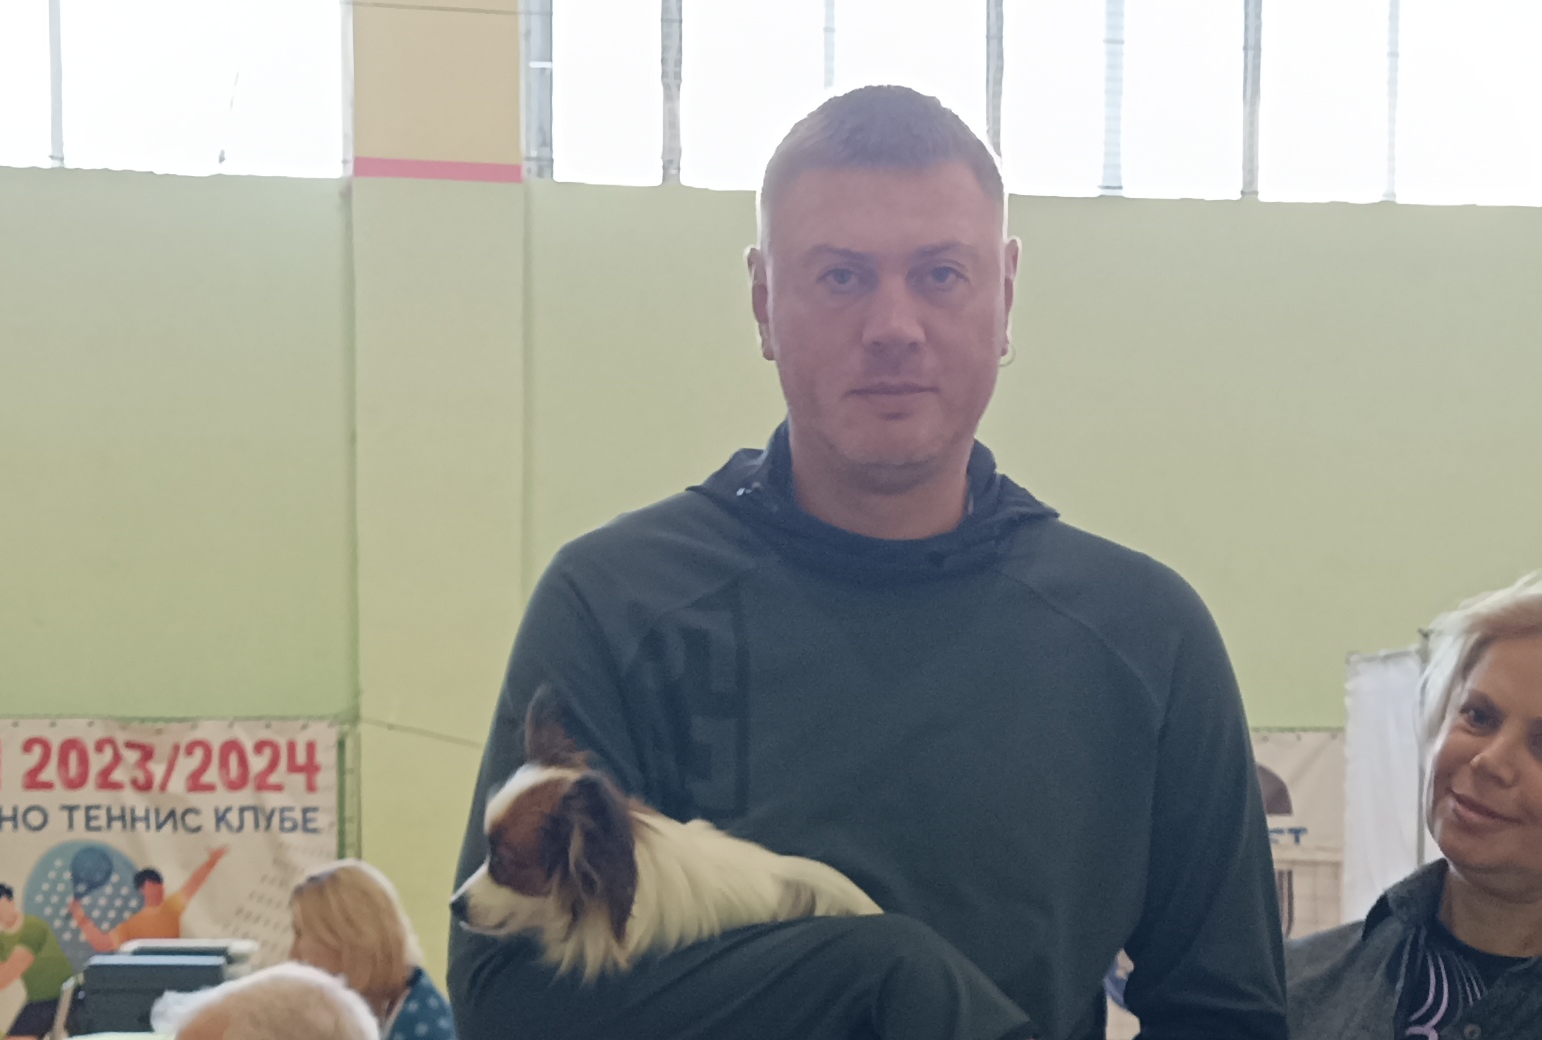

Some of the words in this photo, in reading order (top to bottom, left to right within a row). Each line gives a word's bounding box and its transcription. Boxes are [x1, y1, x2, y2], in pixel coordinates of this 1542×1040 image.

[20, 736, 321, 794] 2023/2024
[61, 803, 202, 834] ТЕННИС
[213, 803, 321, 834] КЛУБЕ
